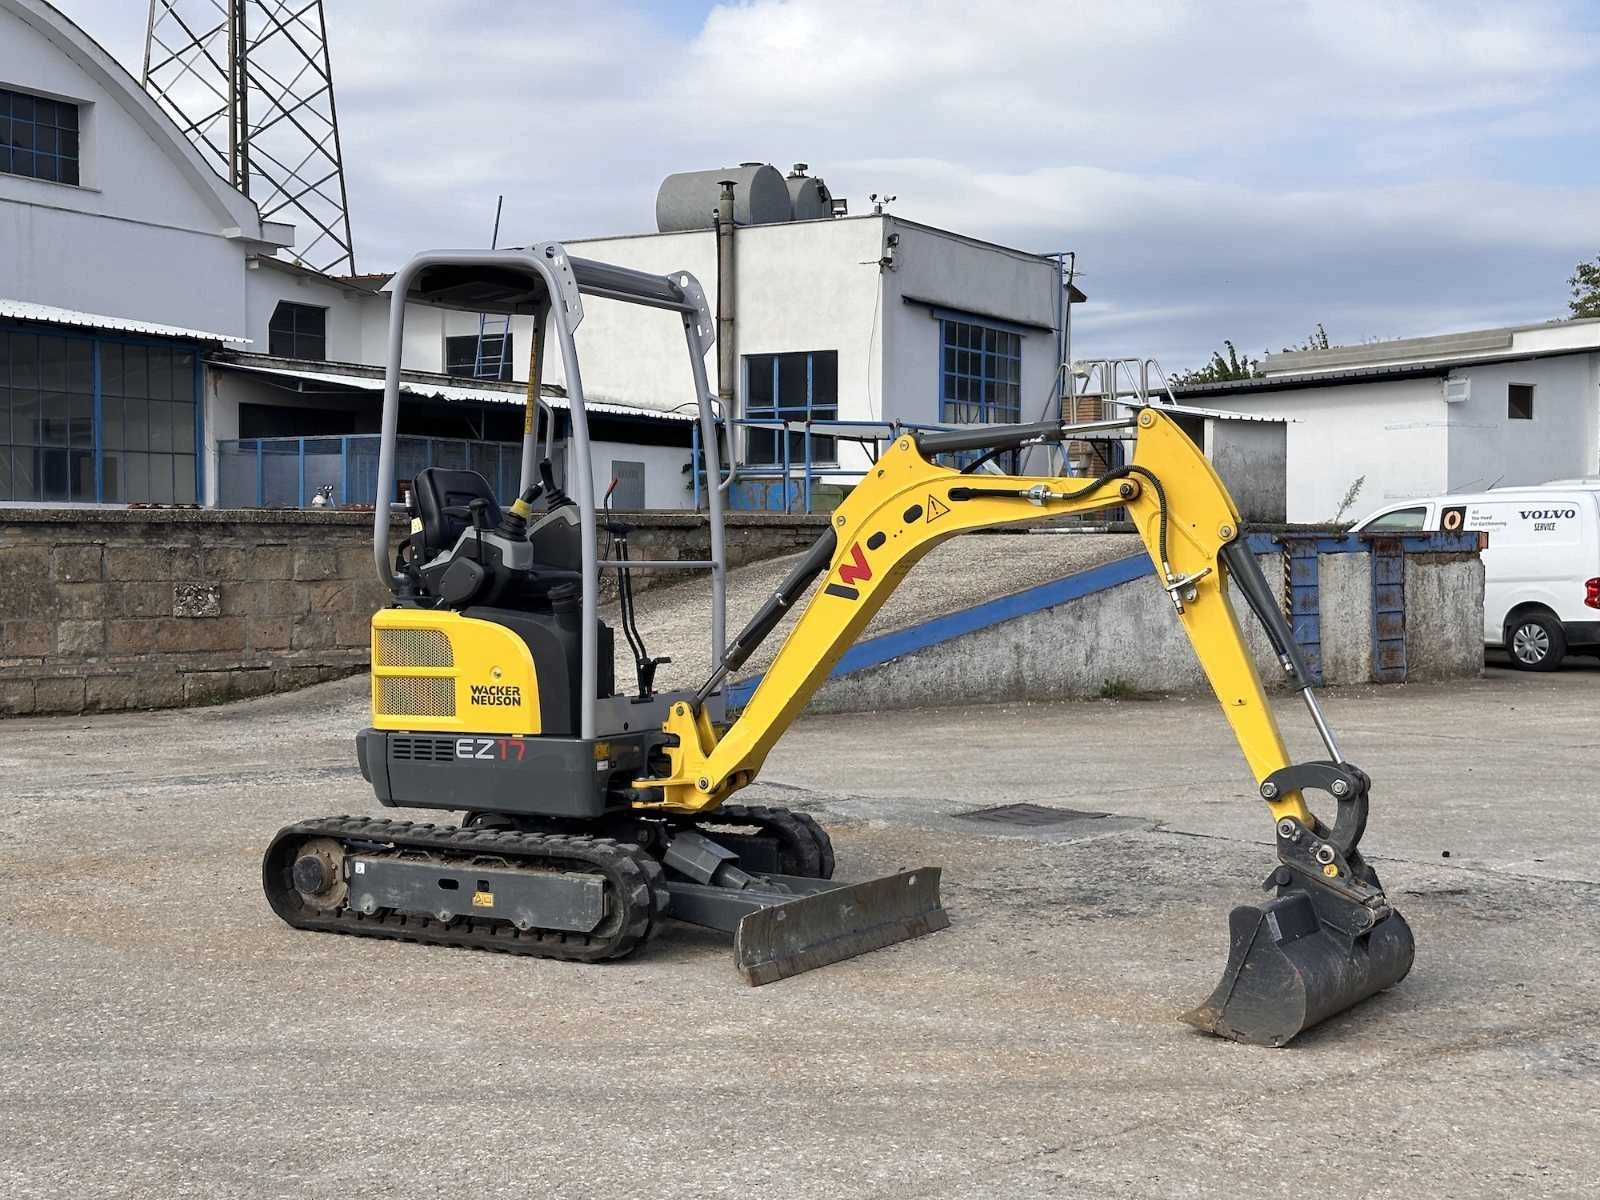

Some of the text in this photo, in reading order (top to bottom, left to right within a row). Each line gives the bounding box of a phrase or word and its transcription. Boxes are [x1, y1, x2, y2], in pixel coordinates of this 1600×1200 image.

[1519, 509, 1576, 519] VOLVO
[1534, 522, 1556, 531] SERVICE
[470, 685, 520, 696] WACKER
[471, 695, 521, 707] NEUSON
[455, 738, 527, 762] EZ17
